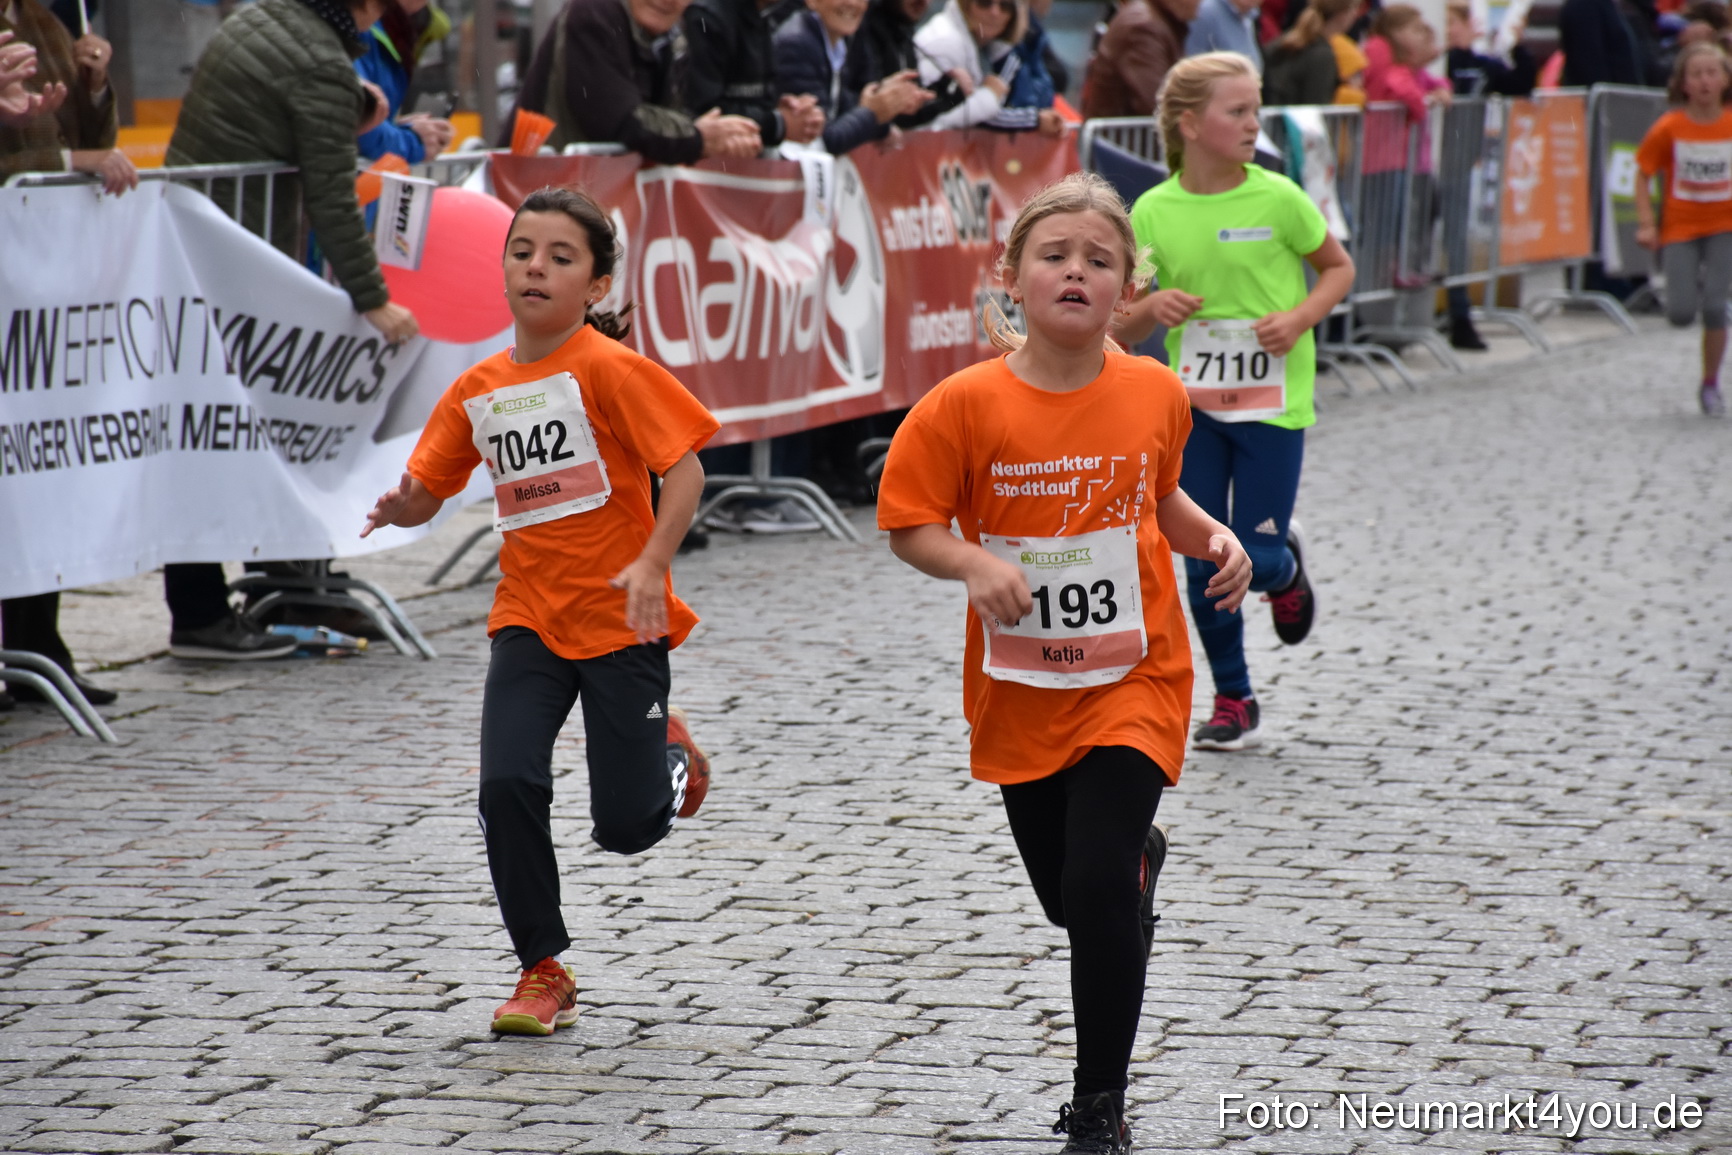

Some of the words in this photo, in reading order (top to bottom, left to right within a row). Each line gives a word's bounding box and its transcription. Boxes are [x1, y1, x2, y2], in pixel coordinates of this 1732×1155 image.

[1196, 351, 1269, 382] 7110
[504, 392, 547, 413] BOCK
[0, 416, 71, 476] ENIGER
[488, 420, 575, 475] 7042
[991, 456, 1103, 477] Neumarkter
[514, 481, 561, 503] Melissa
[993, 476, 1081, 498] Stadtlauf
[1035, 547, 1092, 565] BOCK
[1014, 579, 1118, 629] 193
[1042, 646, 1084, 664] Katja
